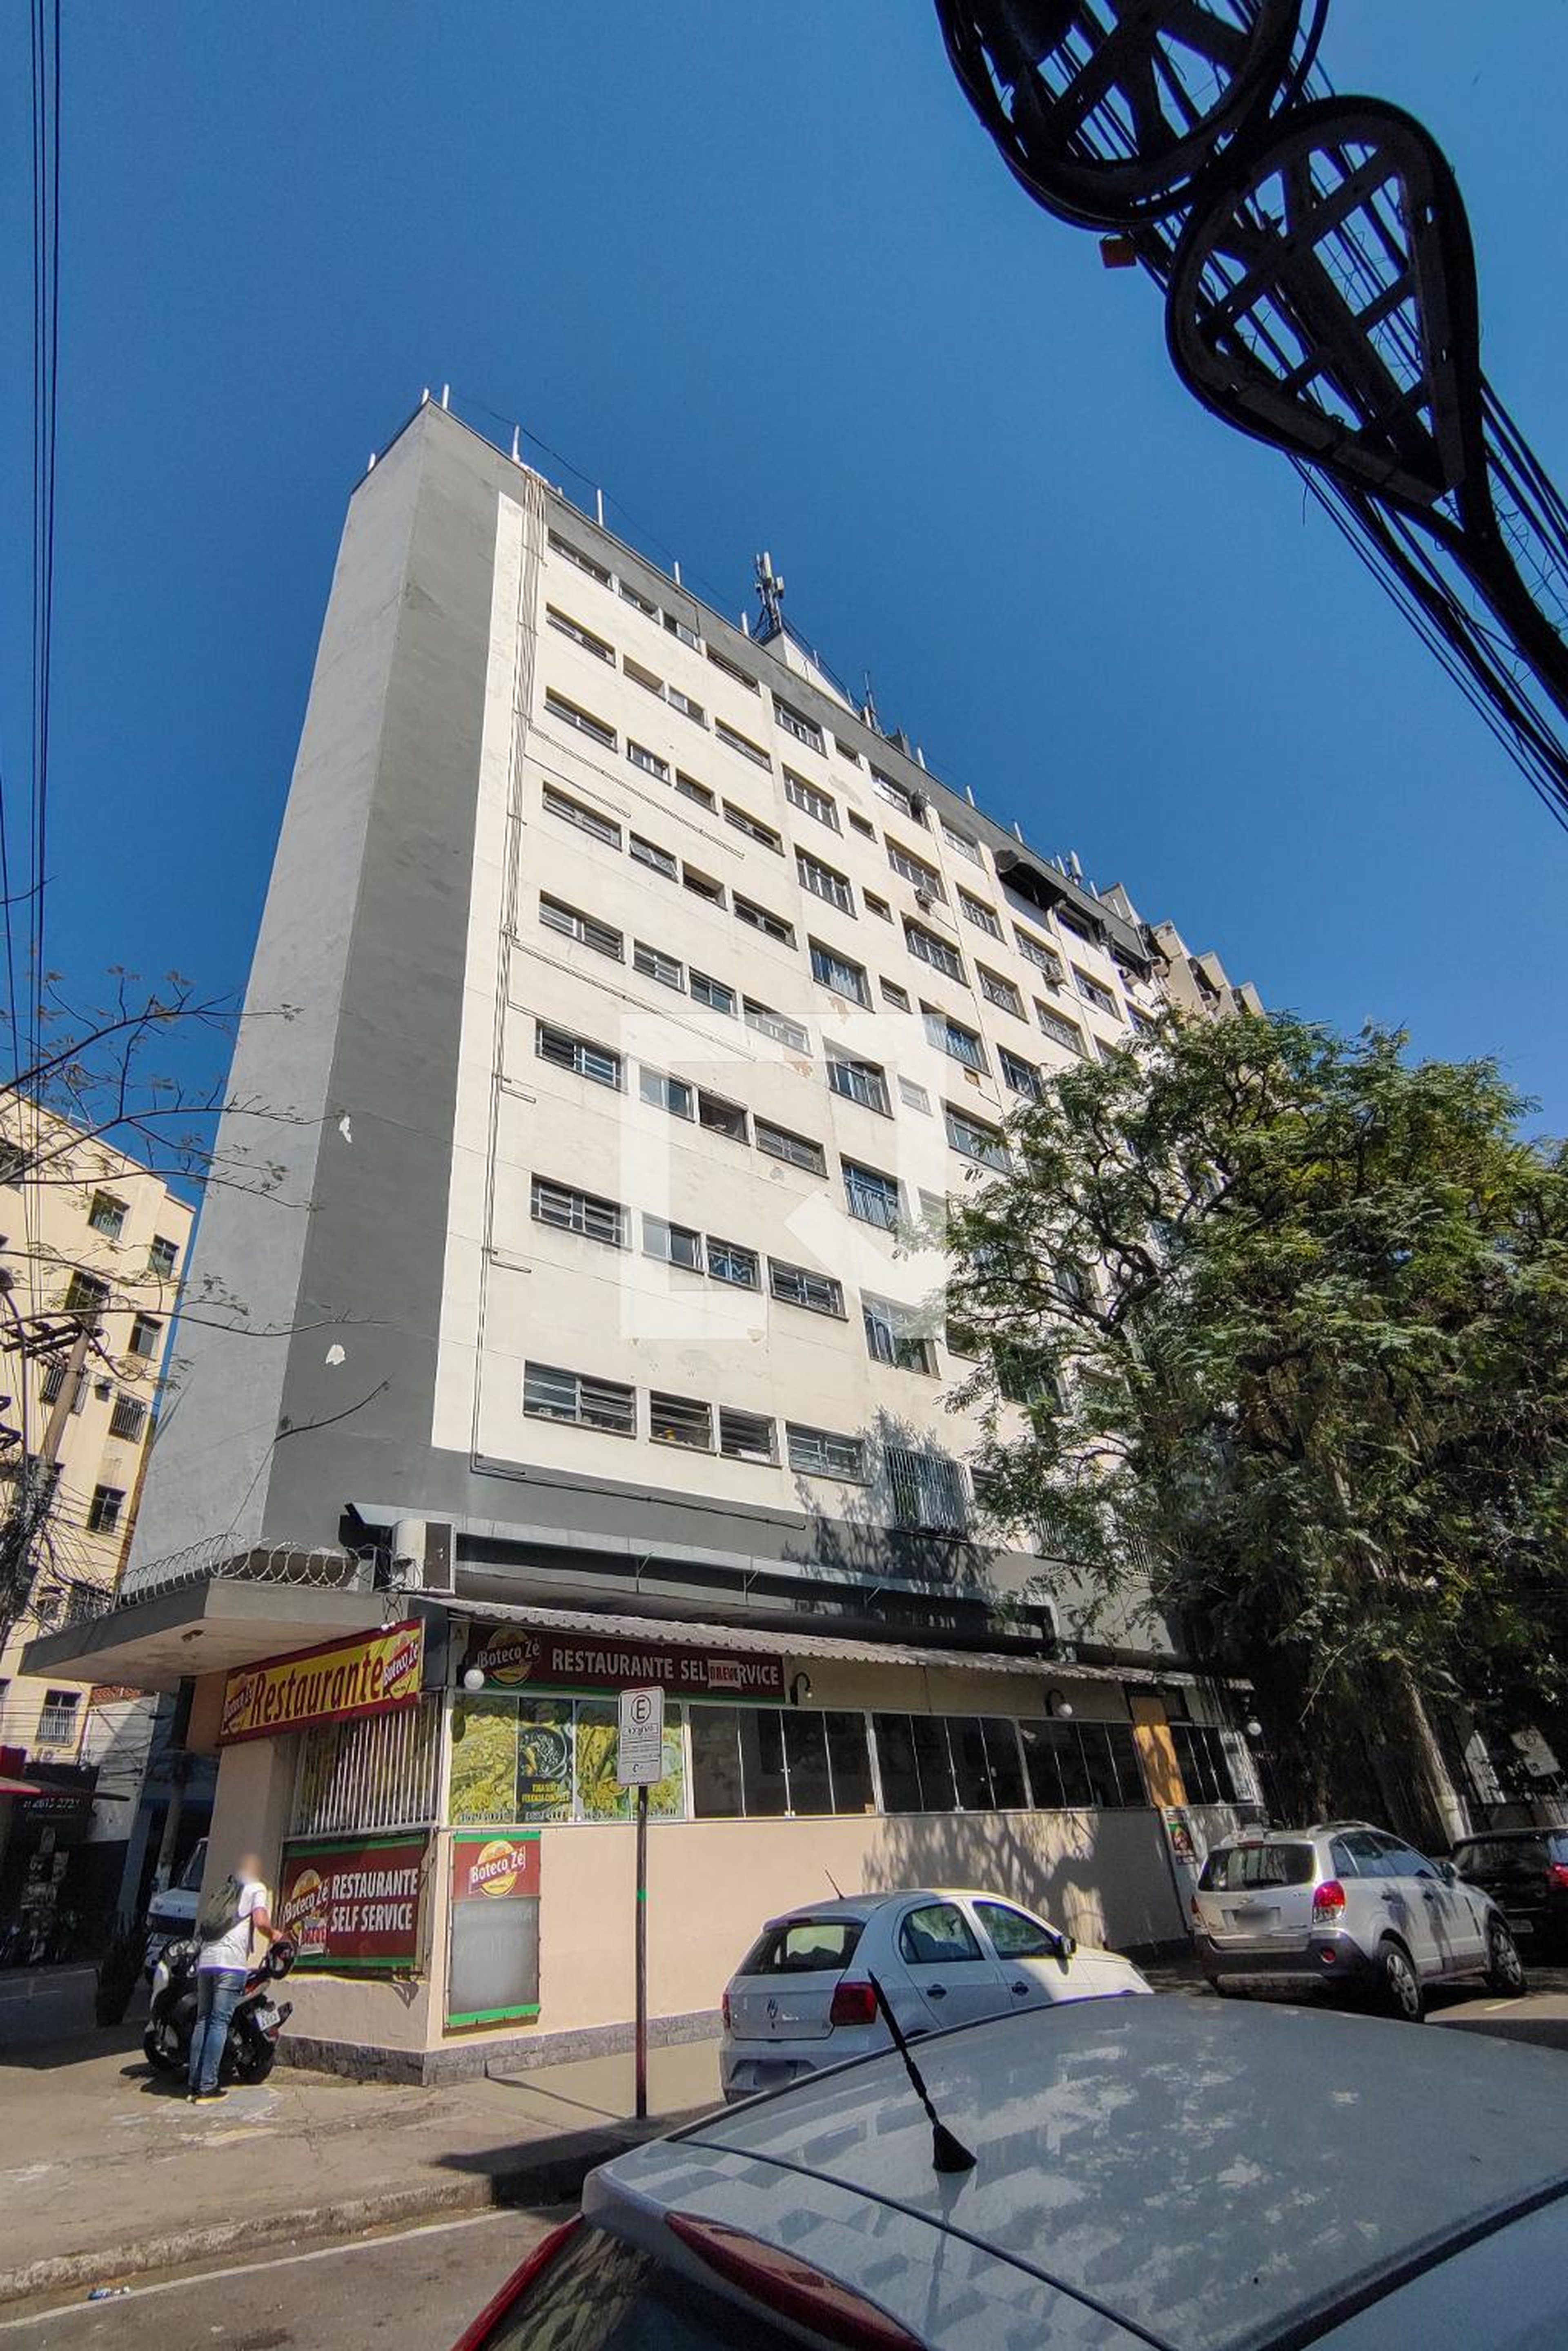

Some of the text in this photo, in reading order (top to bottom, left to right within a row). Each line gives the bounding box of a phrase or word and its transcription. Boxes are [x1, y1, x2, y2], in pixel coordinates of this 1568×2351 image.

[480, 1647, 521, 1668] Boteco
[552, 1648, 674, 1680] RESTAURANTE
[681, 1659, 708, 1682] SEL
[249, 1649, 383, 1726] Restaurante
[637, 1699, 645, 1720] E
[472, 1845, 525, 1884] Boteco Zé
[332, 1868, 418, 1900] RESTAURANTE
[285, 1892, 314, 1923] Boteco
[330, 1903, 412, 1932] SELF SERVICE
